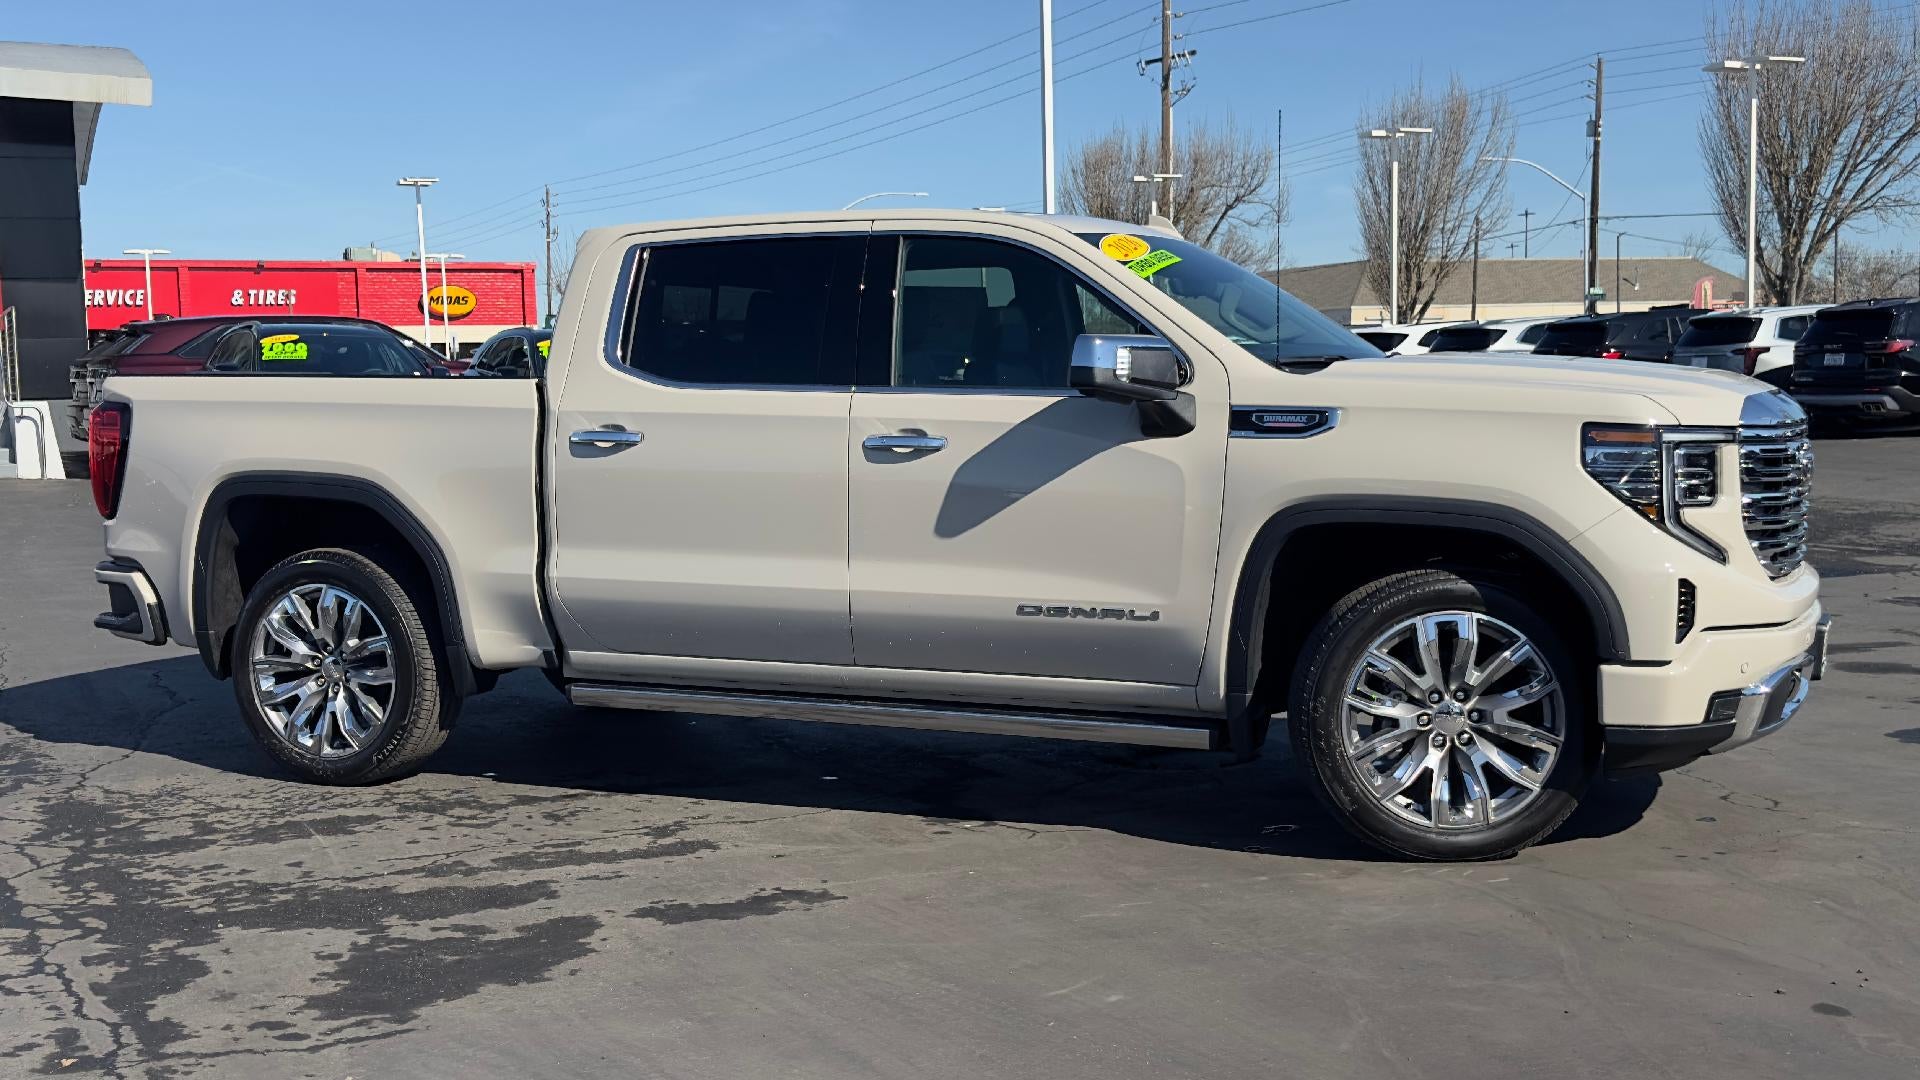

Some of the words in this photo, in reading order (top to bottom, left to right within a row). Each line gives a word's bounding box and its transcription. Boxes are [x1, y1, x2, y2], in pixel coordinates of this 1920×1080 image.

[85, 289, 145, 306] ERVICE
[231, 289, 245, 305] &
[248, 289, 297, 305] TIRES
[429, 295, 469, 306] MIDAS
[1263, 415, 1308, 423] DURAMAX
[1016, 604, 1160, 622] DENALI
